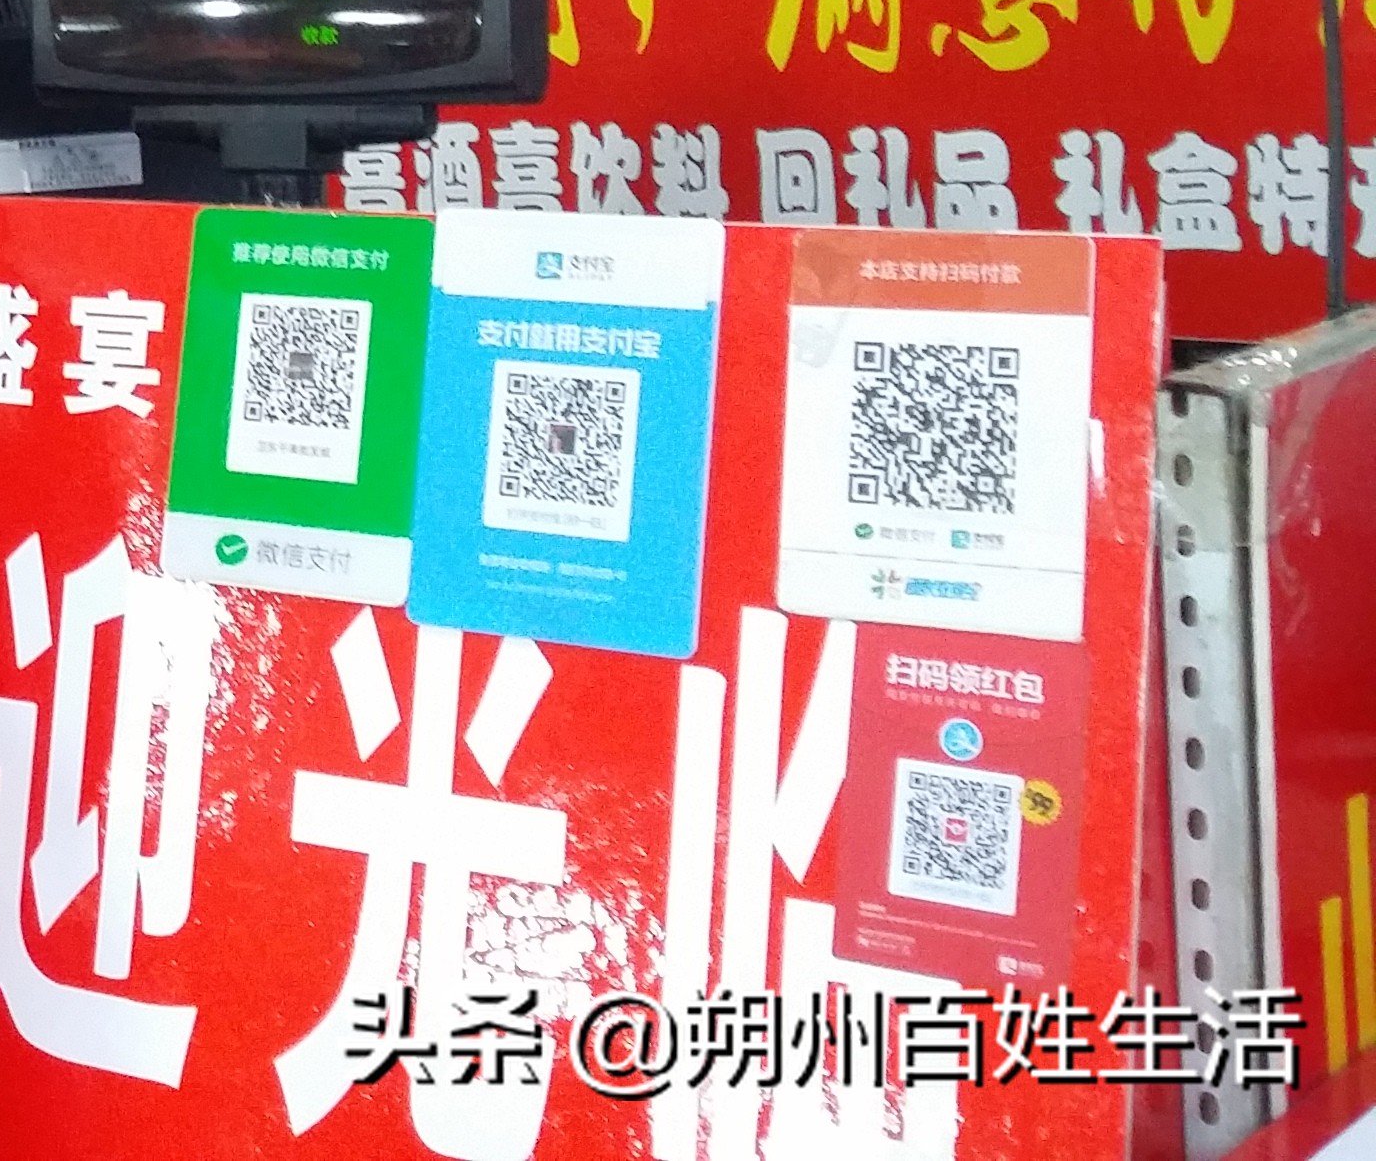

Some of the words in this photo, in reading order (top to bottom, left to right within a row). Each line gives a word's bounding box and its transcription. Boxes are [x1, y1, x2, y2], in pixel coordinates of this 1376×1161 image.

[755, 126, 1018, 230] 回礼品
[232, 242, 390, 271] 推荐使用微信支付
[859, 260, 1022, 285] 本店支持扫码付款
[477, 320, 661, 359] 支付就用支付宝
[256, 538, 352, 574] 微信支付
[886, 653, 1046, 705] 扫码领红包
